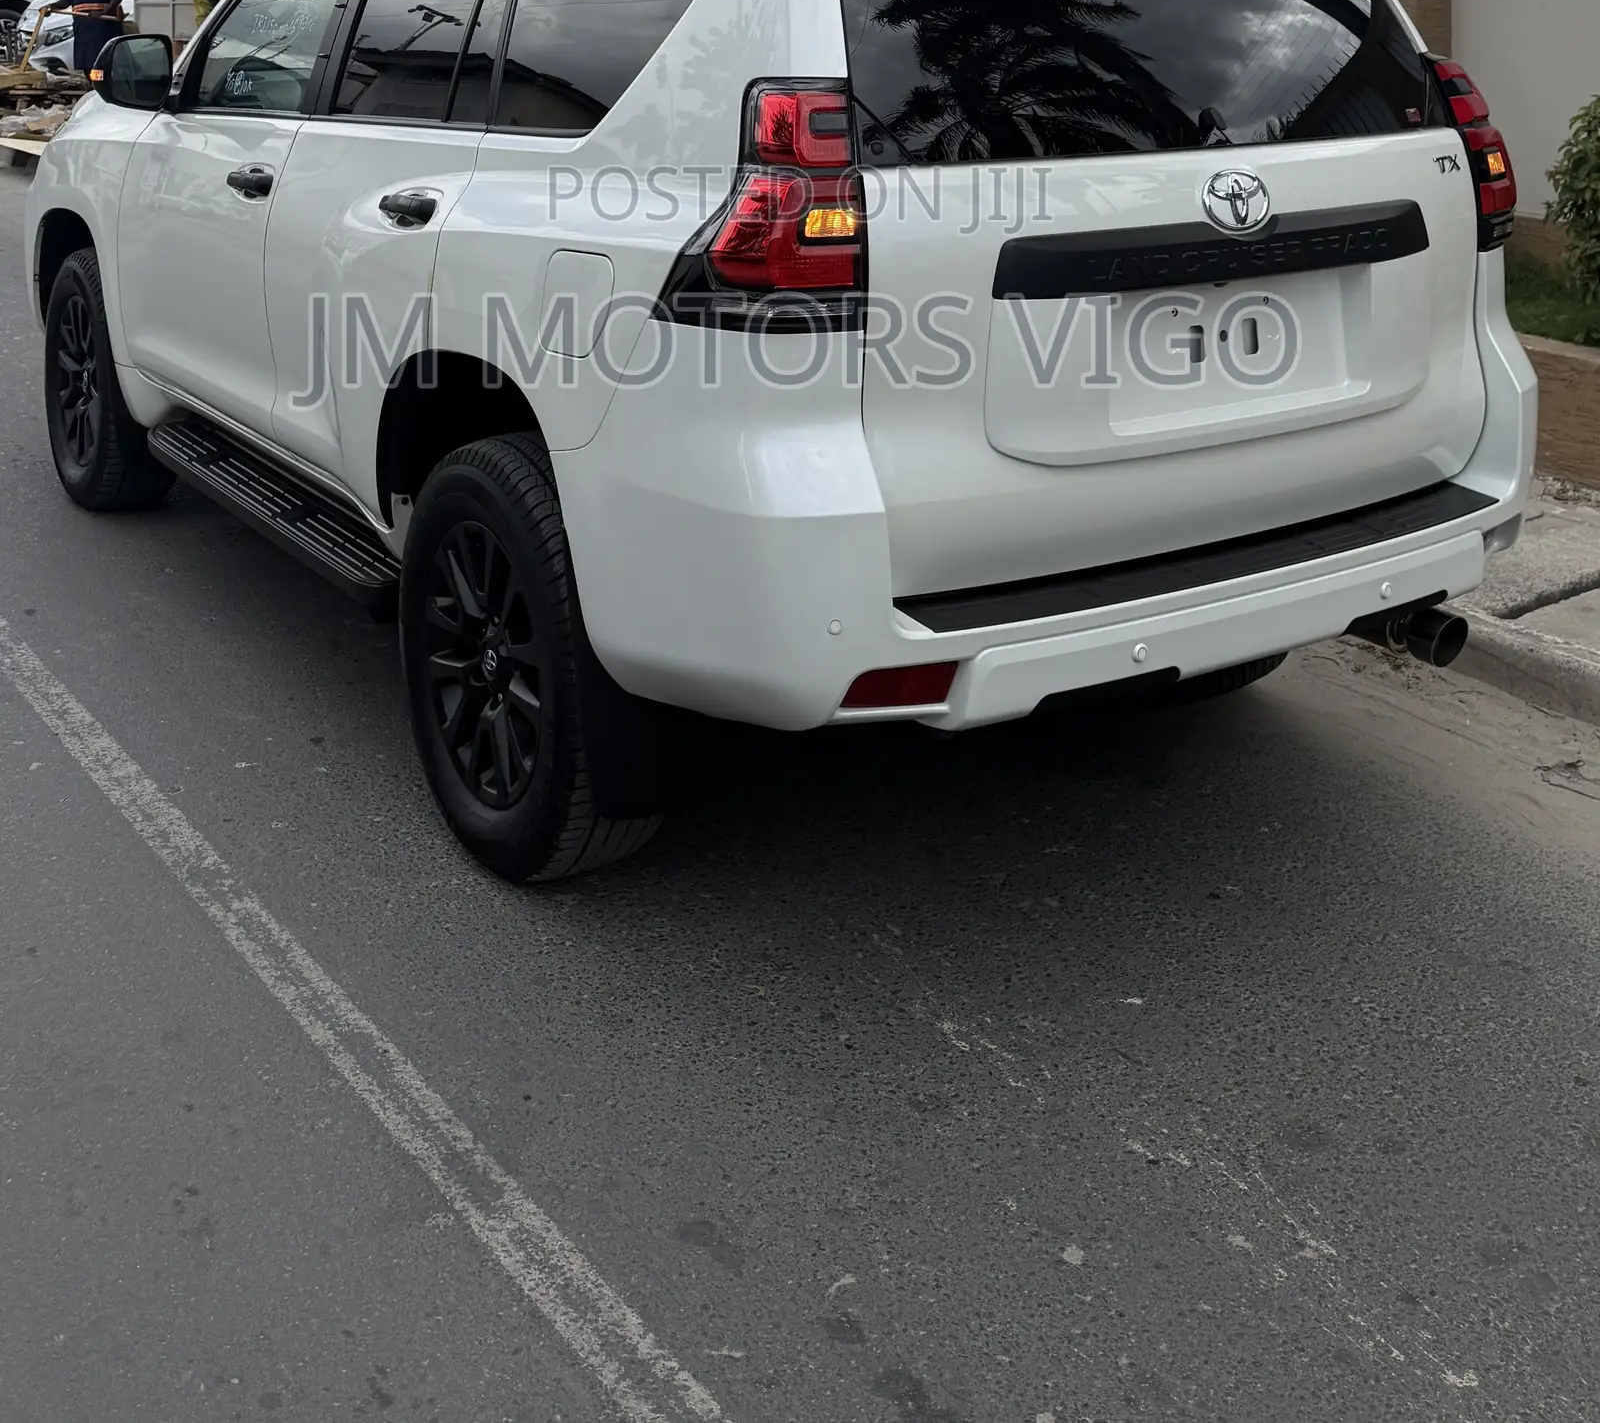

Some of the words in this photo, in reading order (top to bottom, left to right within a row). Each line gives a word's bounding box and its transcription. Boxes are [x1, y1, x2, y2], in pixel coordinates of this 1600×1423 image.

[1433, 153, 1461, 174] TX
[1087, 254, 1171, 281] LAND
[1182, 240, 1302, 273] CRUISER
[1310, 228, 1389, 260] PRADO
